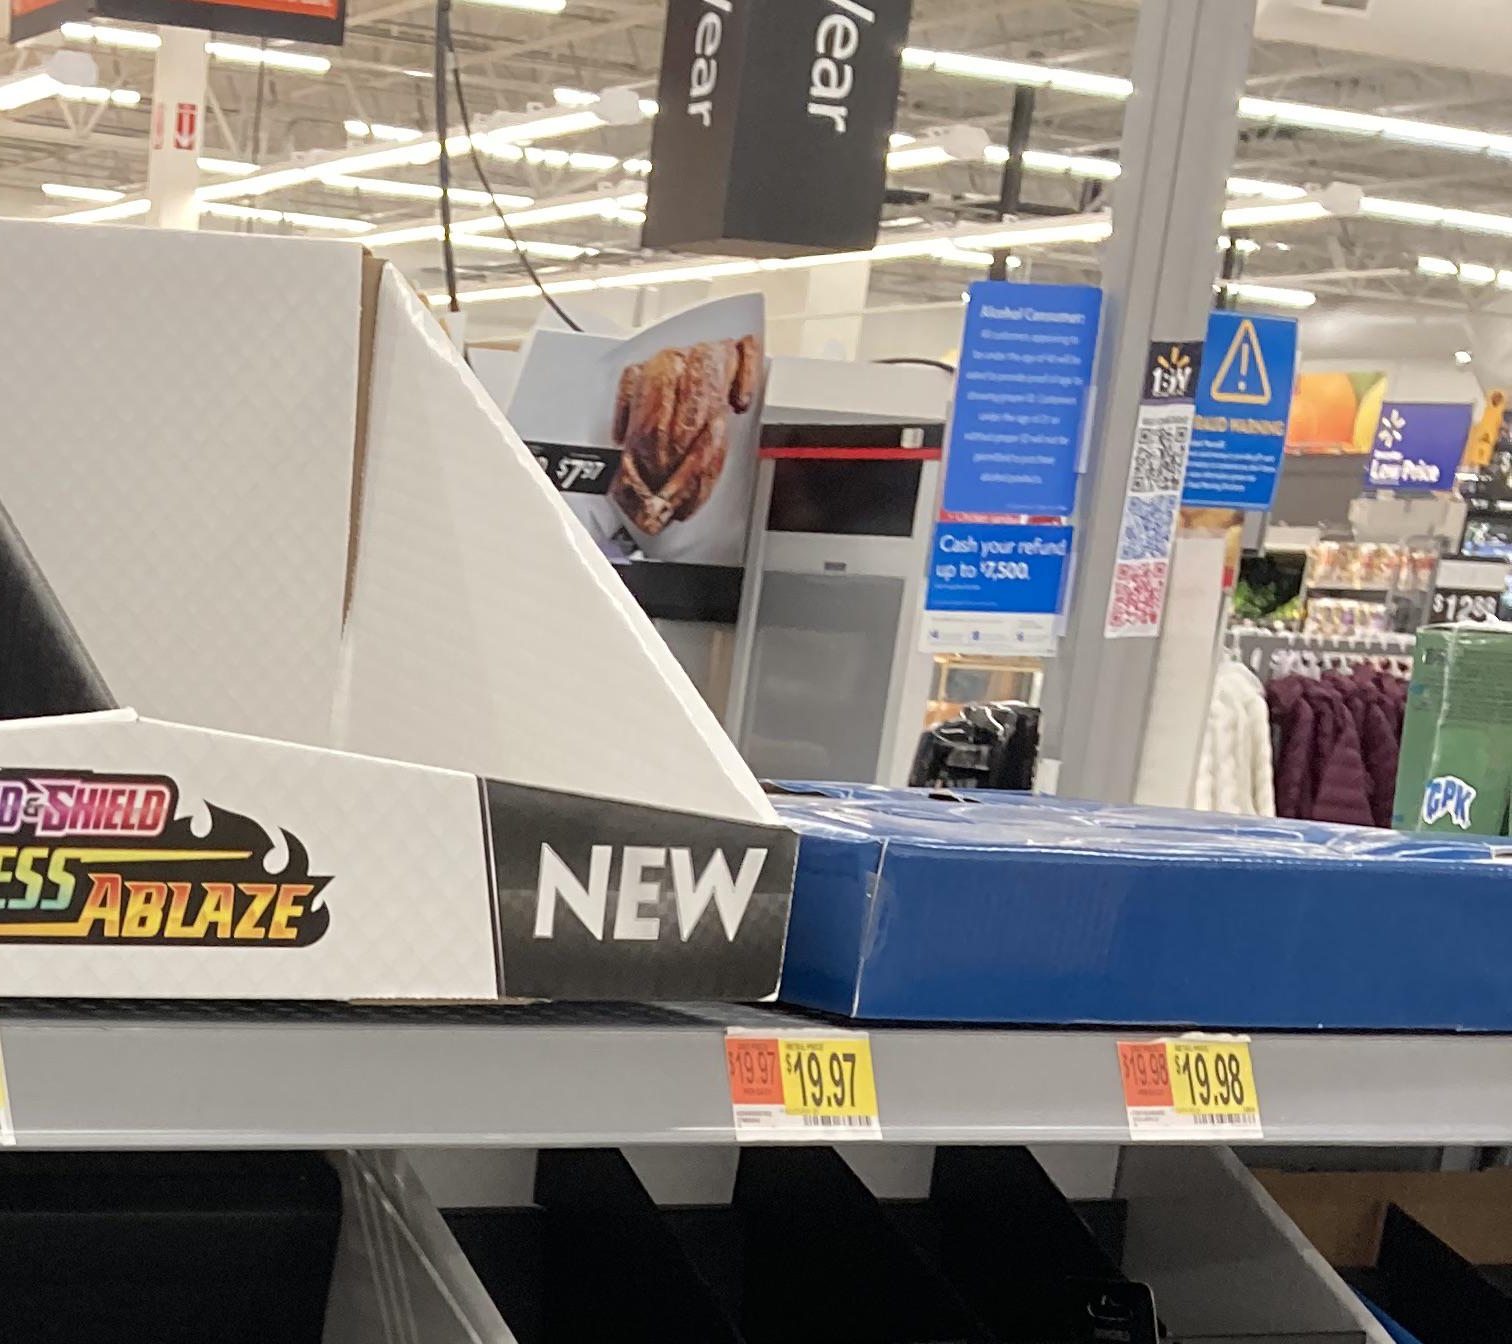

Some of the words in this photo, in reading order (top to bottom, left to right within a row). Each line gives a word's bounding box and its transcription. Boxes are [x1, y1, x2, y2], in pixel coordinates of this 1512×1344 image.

[687, 0, 733, 127] ear
[807, 0, 876, 133] ear
[936, 565, 957, 583] up
[959, 562, 977, 579] to
[939, 535, 978, 554] Cash
[980, 539, 1016, 558] your
[1017, 538, 1067, 556] refund
[37, 778, 170, 834] SHIELD
[85, 873, 314, 940] ABLAZE
[533, 844, 768, 942] NEW
[786, 1052, 856, 1107] $19.97
[1175, 1053, 1244, 1105] $19.98
